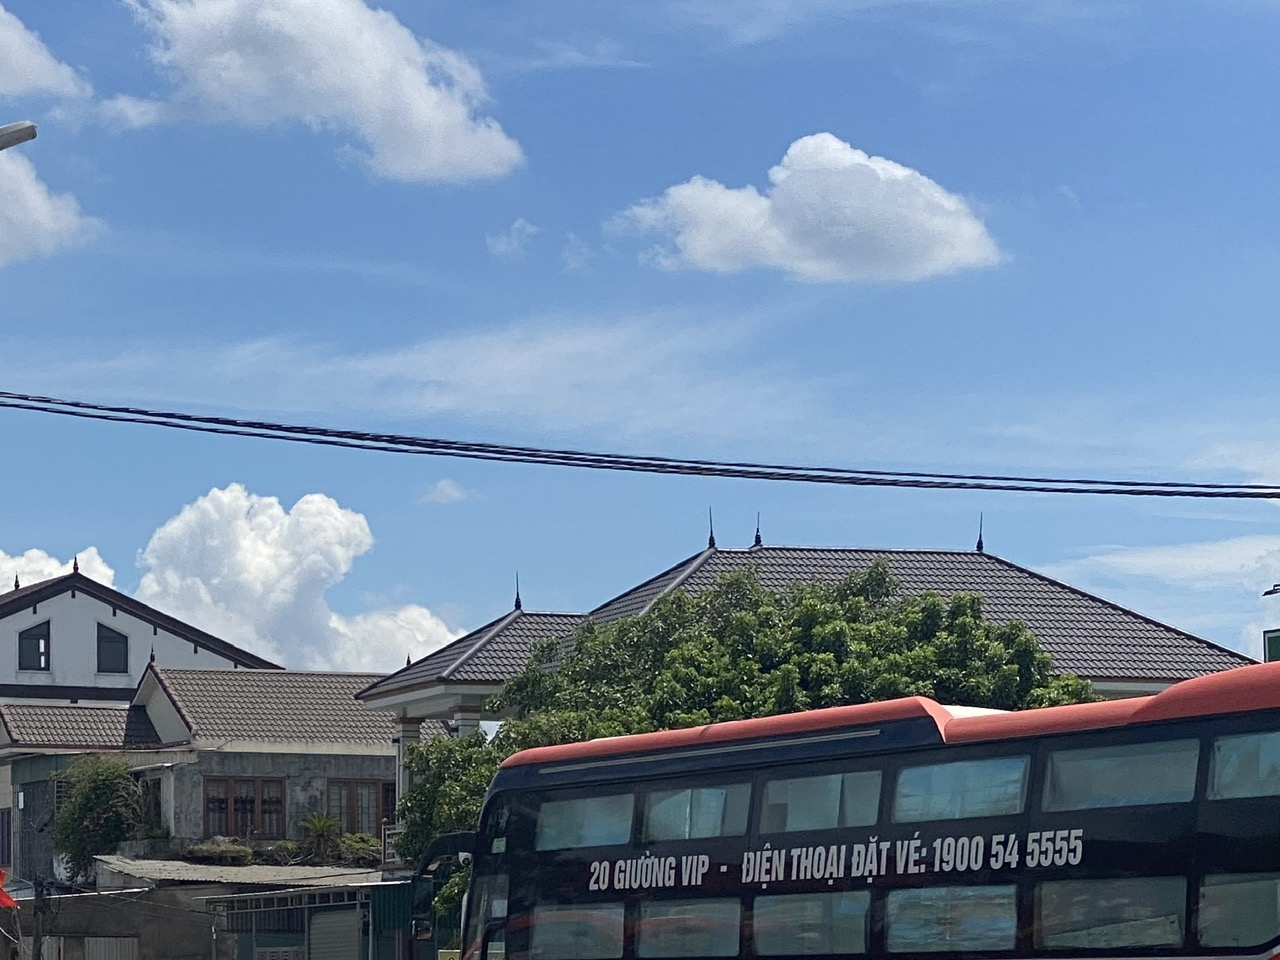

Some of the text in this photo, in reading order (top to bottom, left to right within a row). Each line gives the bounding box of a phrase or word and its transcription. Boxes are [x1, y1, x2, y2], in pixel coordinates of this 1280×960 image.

[588, 860, 610, 891] 20
[613, 850, 676, 890] GIƯỜNG
[680, 854, 710, 886] VIP
[741, 842, 785, 889] ĐIỆN
[790, 844, 847, 886] THOẠI
[851, 836, 891, 884] ĐẶT
[895, 831, 927, 875] VÉ:
[932, 835, 984, 873] 1900
[989, 833, 1019, 869] 54
[1025, 828, 1084, 869] 5555
